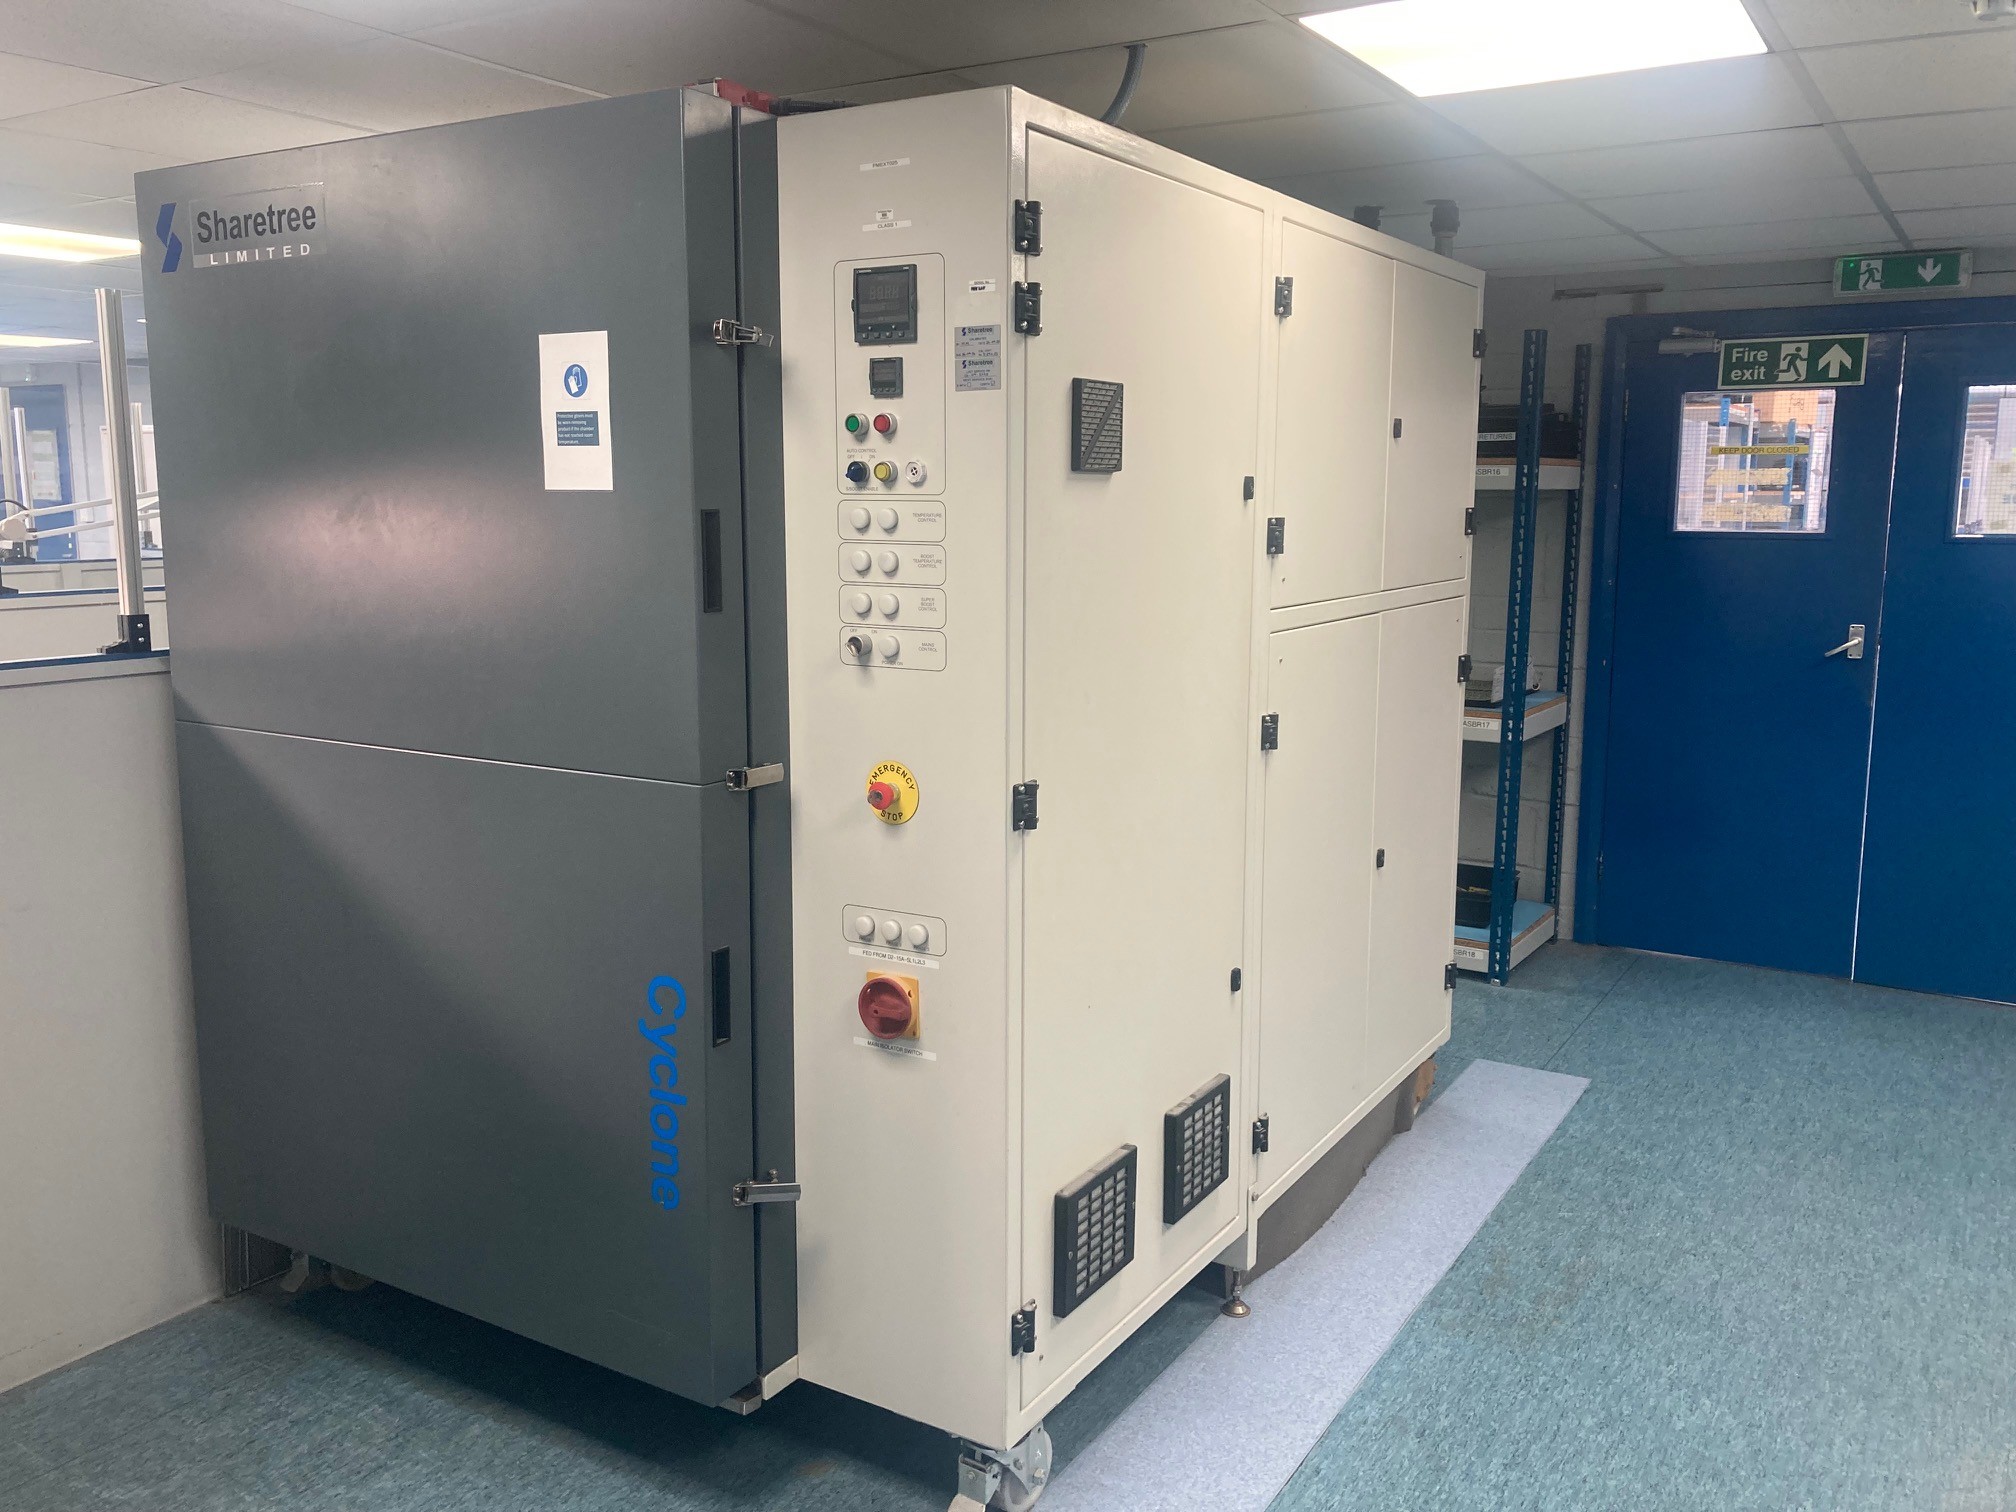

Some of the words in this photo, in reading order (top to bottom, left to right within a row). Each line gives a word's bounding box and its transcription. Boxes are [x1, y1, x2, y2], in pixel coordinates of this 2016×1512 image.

[196, 203, 316, 244] Sharetree
[209, 243, 311, 266] LIMITED
[1731, 347, 1768, 363] Fire
[1730, 365, 1767, 381] exit
[1478, 433, 1513, 441] RETURNS
[1766, 446, 1800, 454] CLOSED
[868, 764, 916, 791] EMERGENCY
[880, 809, 904, 822] STOP
[862, 949, 873, 957] FED
[872, 951, 887, 959] FROM
[903, 1048, 923, 1057] SWITCH
[637, 975, 687, 1211] Cyclone
